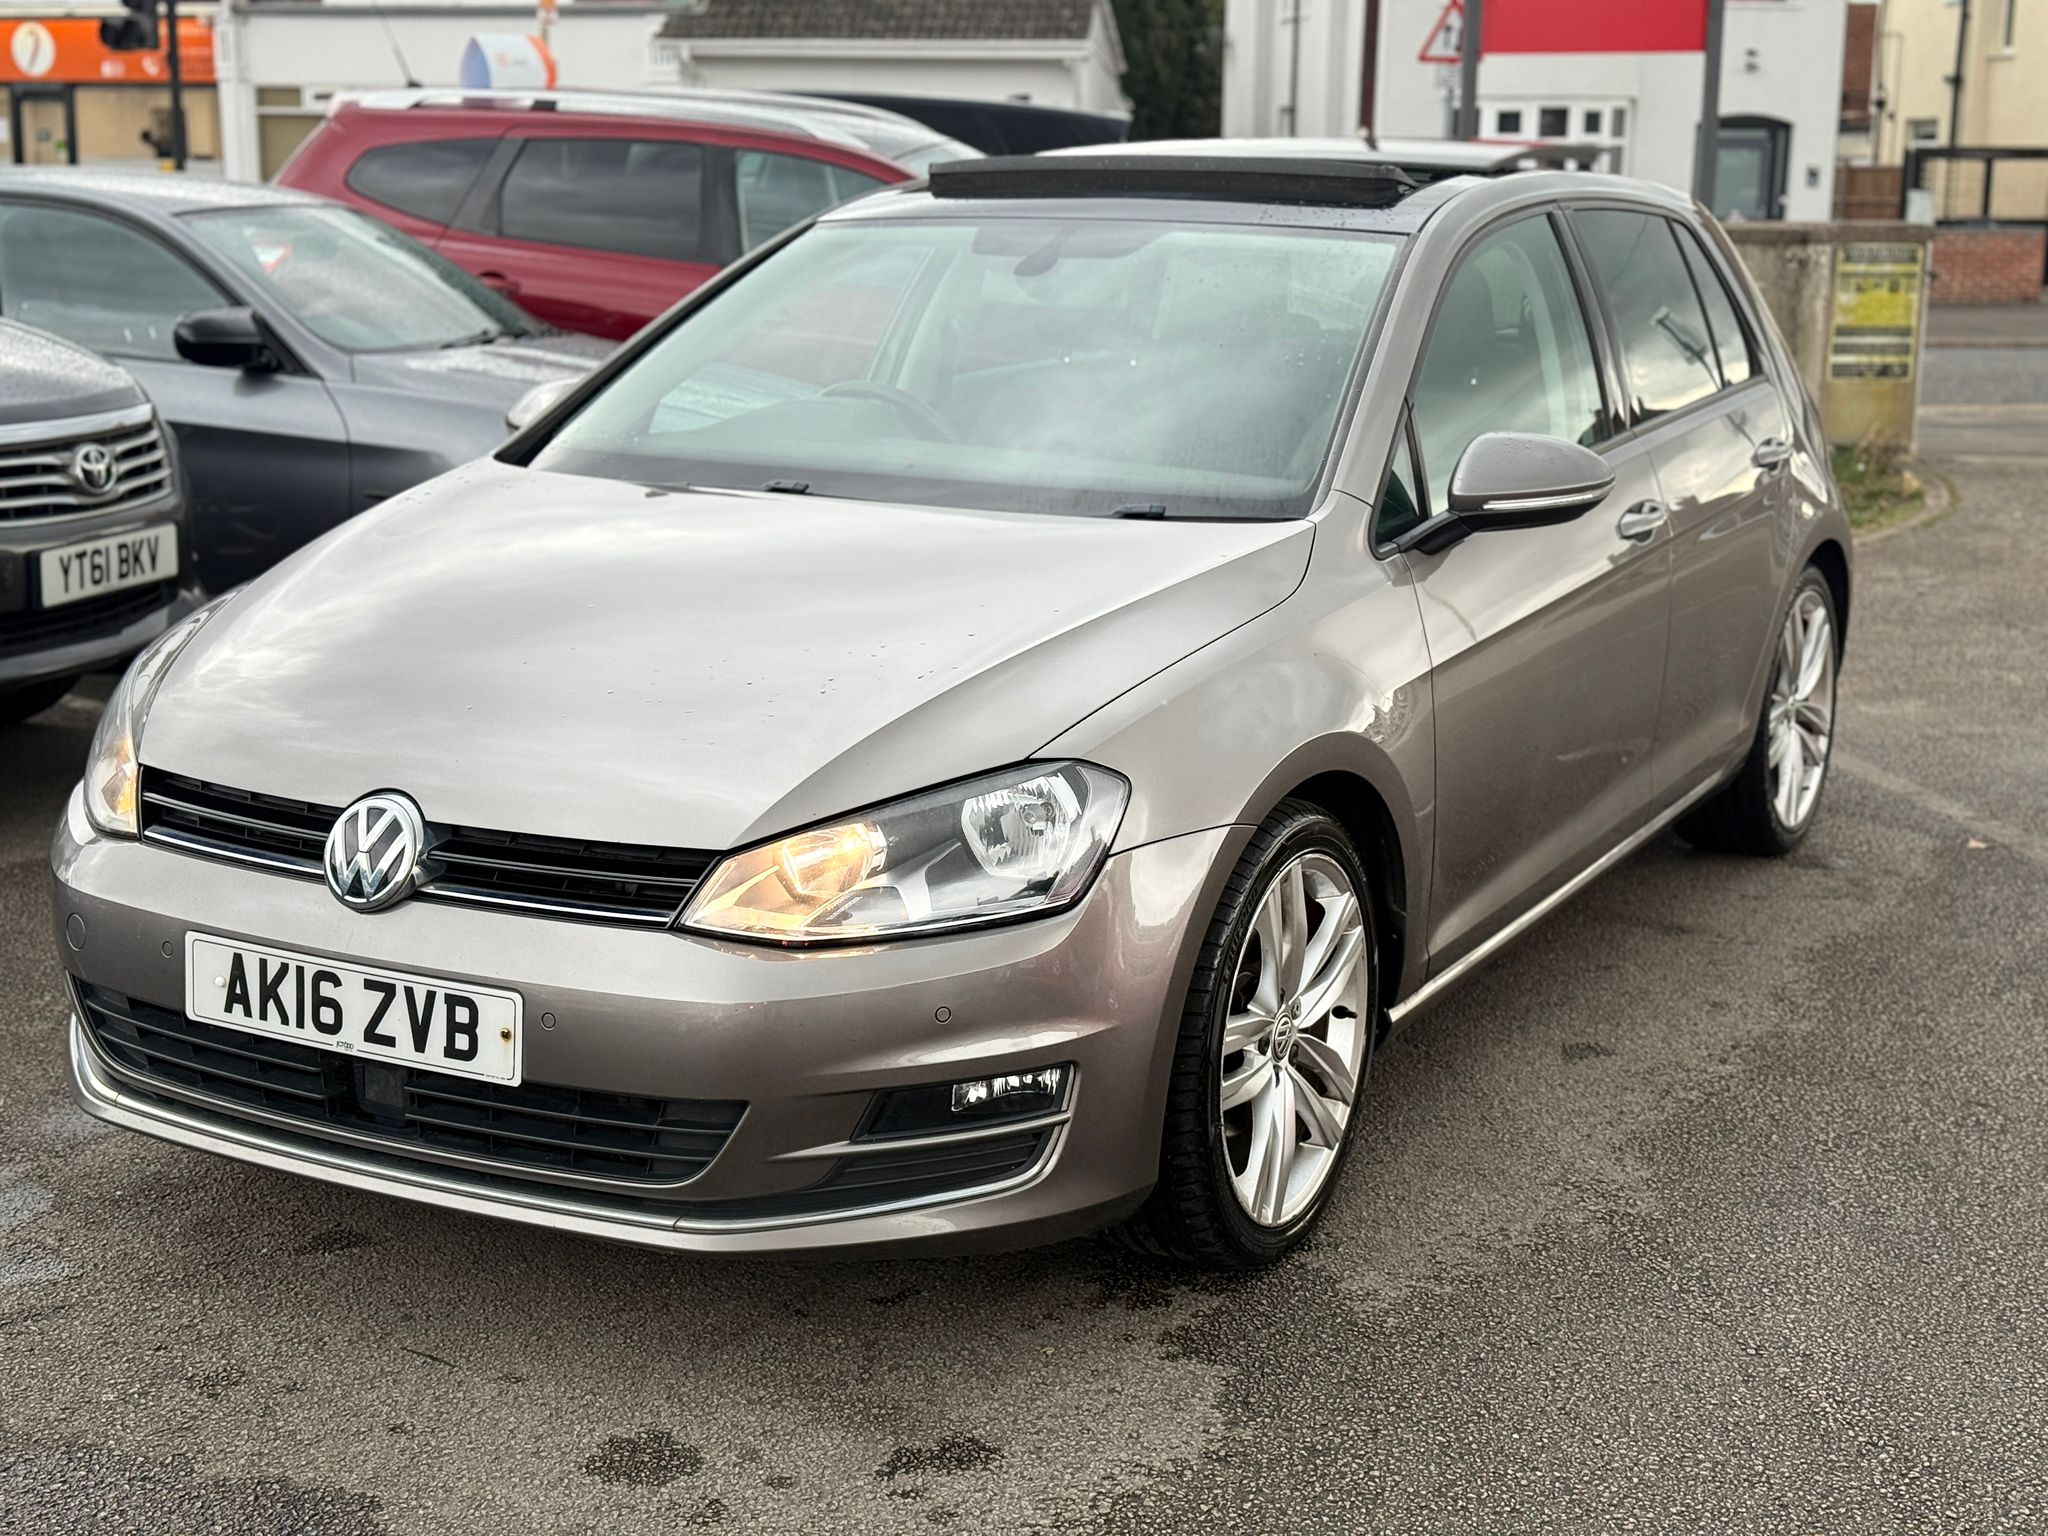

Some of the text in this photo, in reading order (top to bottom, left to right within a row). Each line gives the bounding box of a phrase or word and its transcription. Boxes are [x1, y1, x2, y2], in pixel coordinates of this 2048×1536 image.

[58, 535, 160, 593] YT61 BKV
[223, 952, 480, 1063] AK16 ZVB
